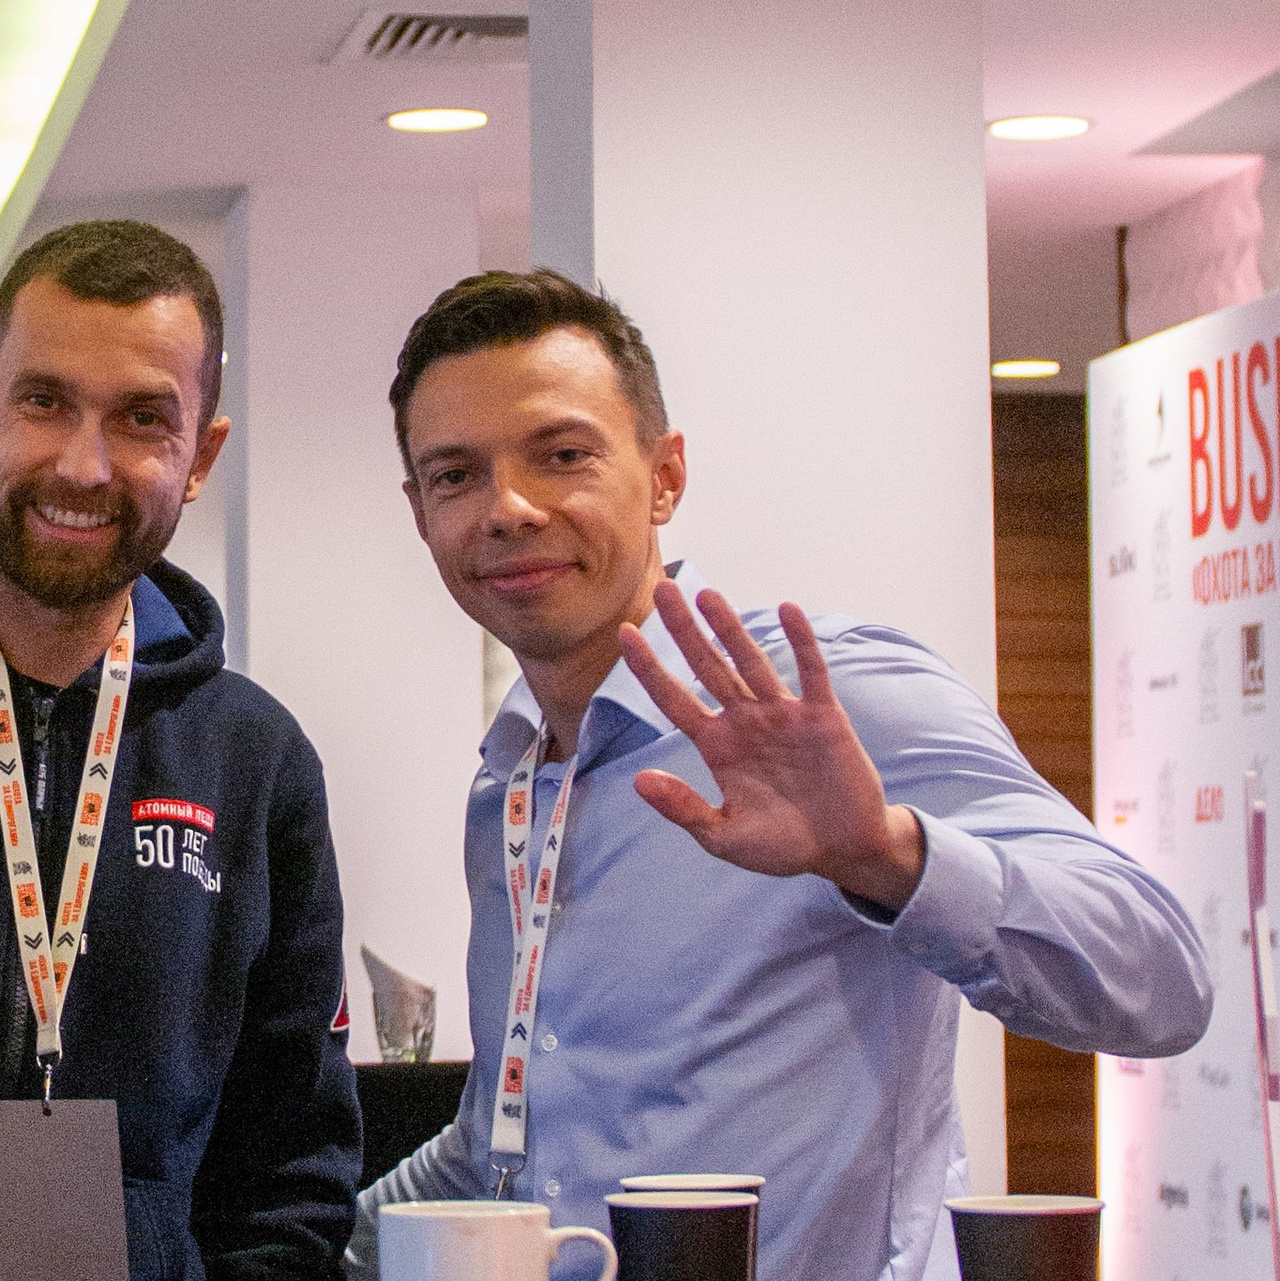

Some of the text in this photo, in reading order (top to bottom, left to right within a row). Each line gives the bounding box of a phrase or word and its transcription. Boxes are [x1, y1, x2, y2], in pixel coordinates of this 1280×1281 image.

[139, 802, 193, 818] АТОМНЫЙ
[135, 824, 208, 869] 50 ЛЕТ
